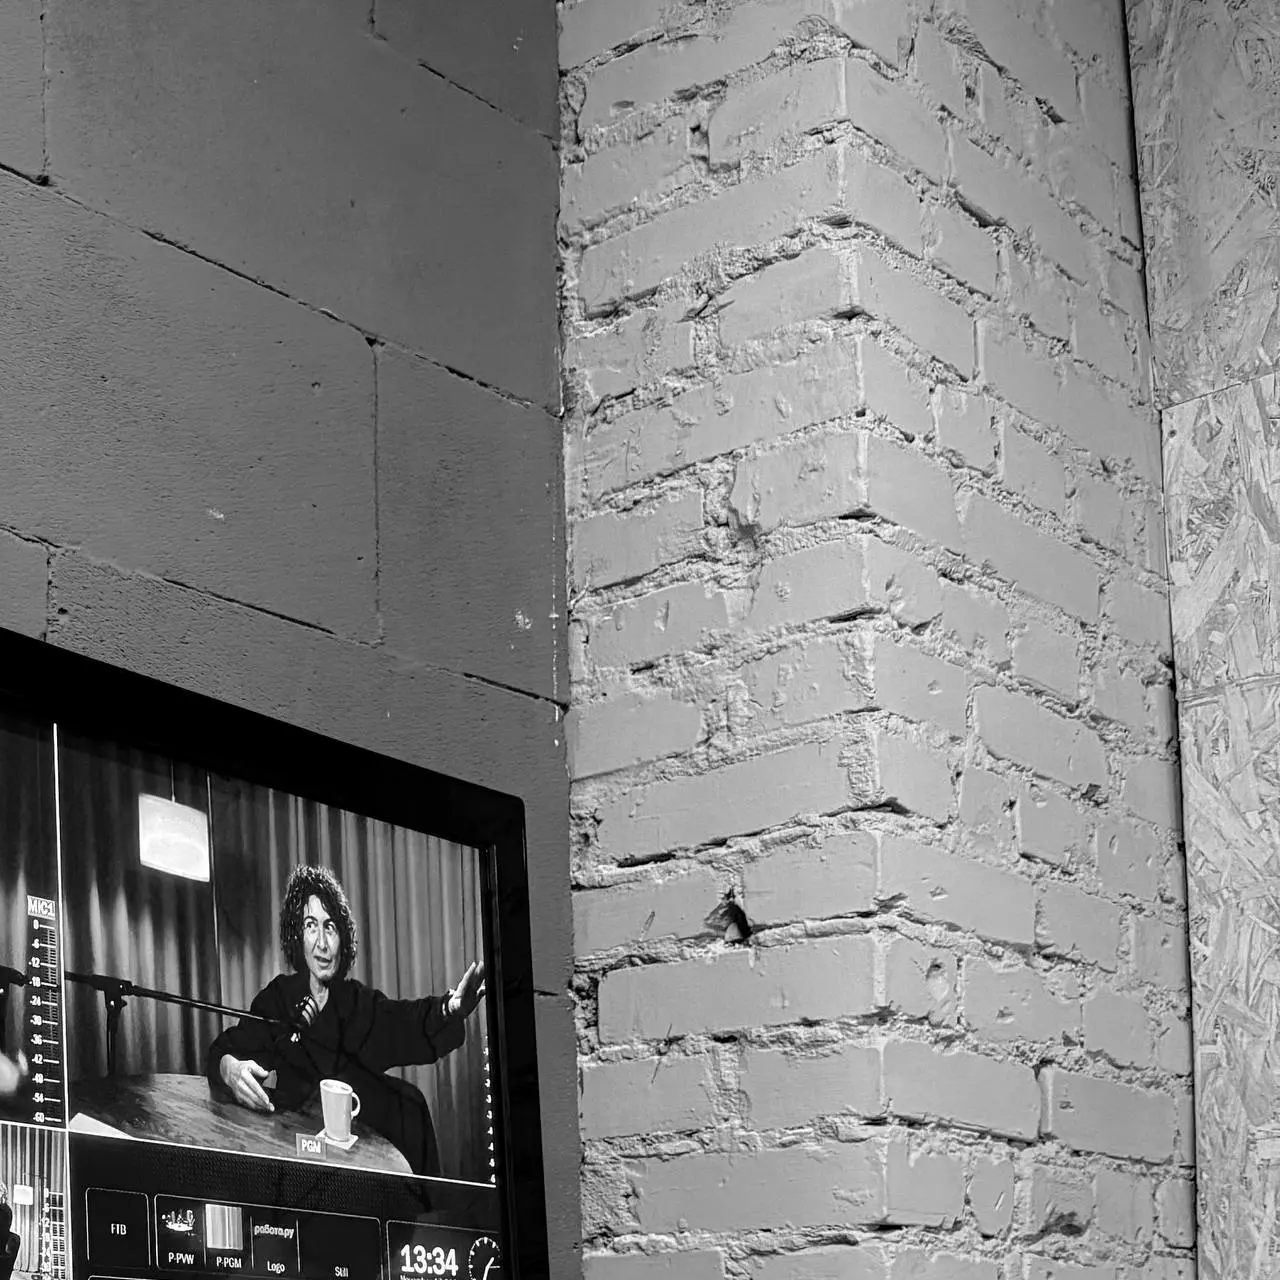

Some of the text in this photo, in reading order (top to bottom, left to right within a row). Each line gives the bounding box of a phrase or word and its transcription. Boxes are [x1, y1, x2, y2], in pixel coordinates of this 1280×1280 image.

[301, 1138, 321, 1154] PGM
[168, 1252, 195, 1265] P-PVW
[216, 1256, 242, 1269] P-PGM
[400, 1244, 459, 1277] 13:34
[267, 1260, 285, 1274] Logo
